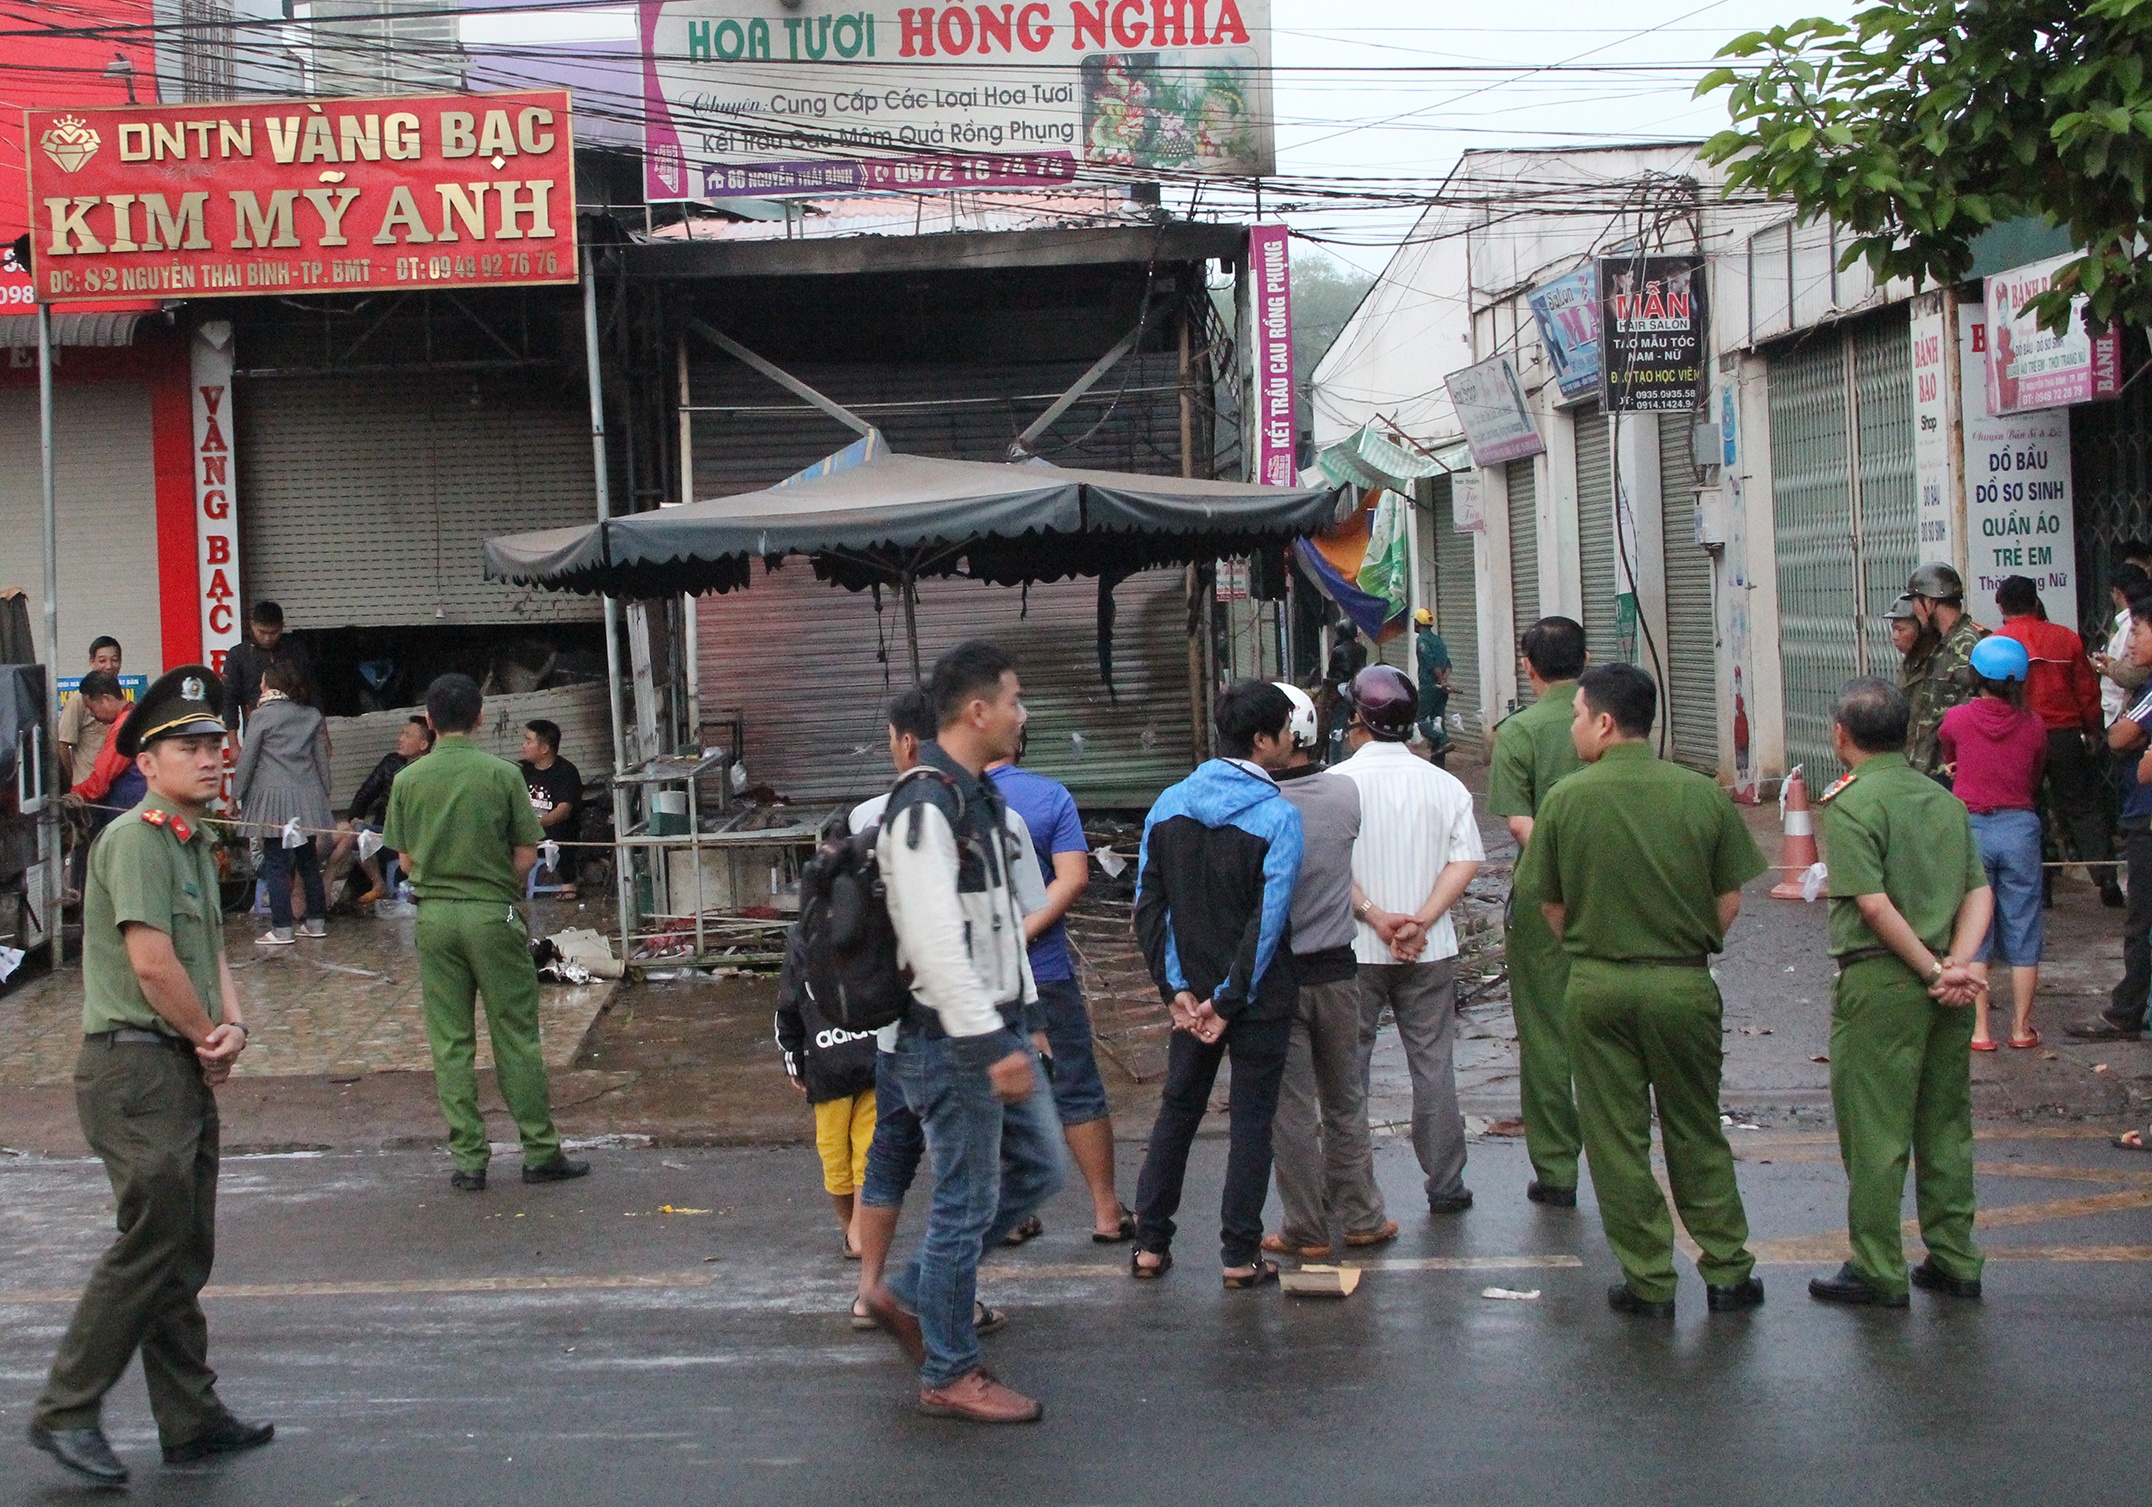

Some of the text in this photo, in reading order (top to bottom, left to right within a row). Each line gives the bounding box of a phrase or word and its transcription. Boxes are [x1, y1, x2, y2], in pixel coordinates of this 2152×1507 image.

[688, 17, 770, 63] HOA
[783, 11, 875, 61] TƯƠI
[770, 94, 826, 117] Cung
[834, 88, 877, 114] Cấp
[884, 88, 928, 110] Các
[936, 87, 977, 111] Loại
[984, 86, 1026, 106] Hoa
[1032, 83, 1073, 103] Tươi
[118, 103, 555, 170] DNTN VÀNG BẠC
[899, 120, 943, 145] Quả
[951, 119, 1002, 146] Rồng
[1010, 120, 1074, 144] Phụng
[894, 161, 953, 183] 0972
[44, 170, 556, 256] KIM MỸ ANH
[84, 267, 119, 292] 82
[122, 258, 196, 291] NGUYỄN
[201, 259, 242, 289] THÁI
[332, 258, 370, 283] BMT
[454, 255, 476, 278] 48
[481, 253, 502, 277] 92
[508, 253, 530, 275] 76
[536, 251, 558, 274] 76
[1263, 240, 1288, 293] PHỤNG
[1262, 296, 1287, 338] RỒNG
[1620, 320, 1688, 330] HAIR SALON
[1628, 351, 1654, 361] NAM
[1665, 349, 1682, 360] NỮ
[1641, 333, 1667, 348] MẪU
[1670, 335, 1695, 347] TÓC
[1914, 331, 1939, 368] BÁNH
[1269, 342, 1288, 374] CAU
[1634, 370, 1654, 385] TẠO
[1655, 370, 1676, 384] HỌC
[1919, 372, 1937, 403] BAO
[1264, 377, 1289, 417] TRẦU
[1264, 420, 1290, 448] KẾT
[1921, 415, 1937, 432] Shop
[199, 385, 229, 520] VÀNG
[1989, 443, 2048, 472] ĐỒ BẦU
[1976, 476, 2064, 503] ĐỒ SƠ SINH
[1982, 509, 2060, 537] QUẦN ÁO
[1993, 539, 2052, 567] TRẺ EM
[206, 535, 233, 635] BẠC
[2049, 572, 2067, 587] Nữ
